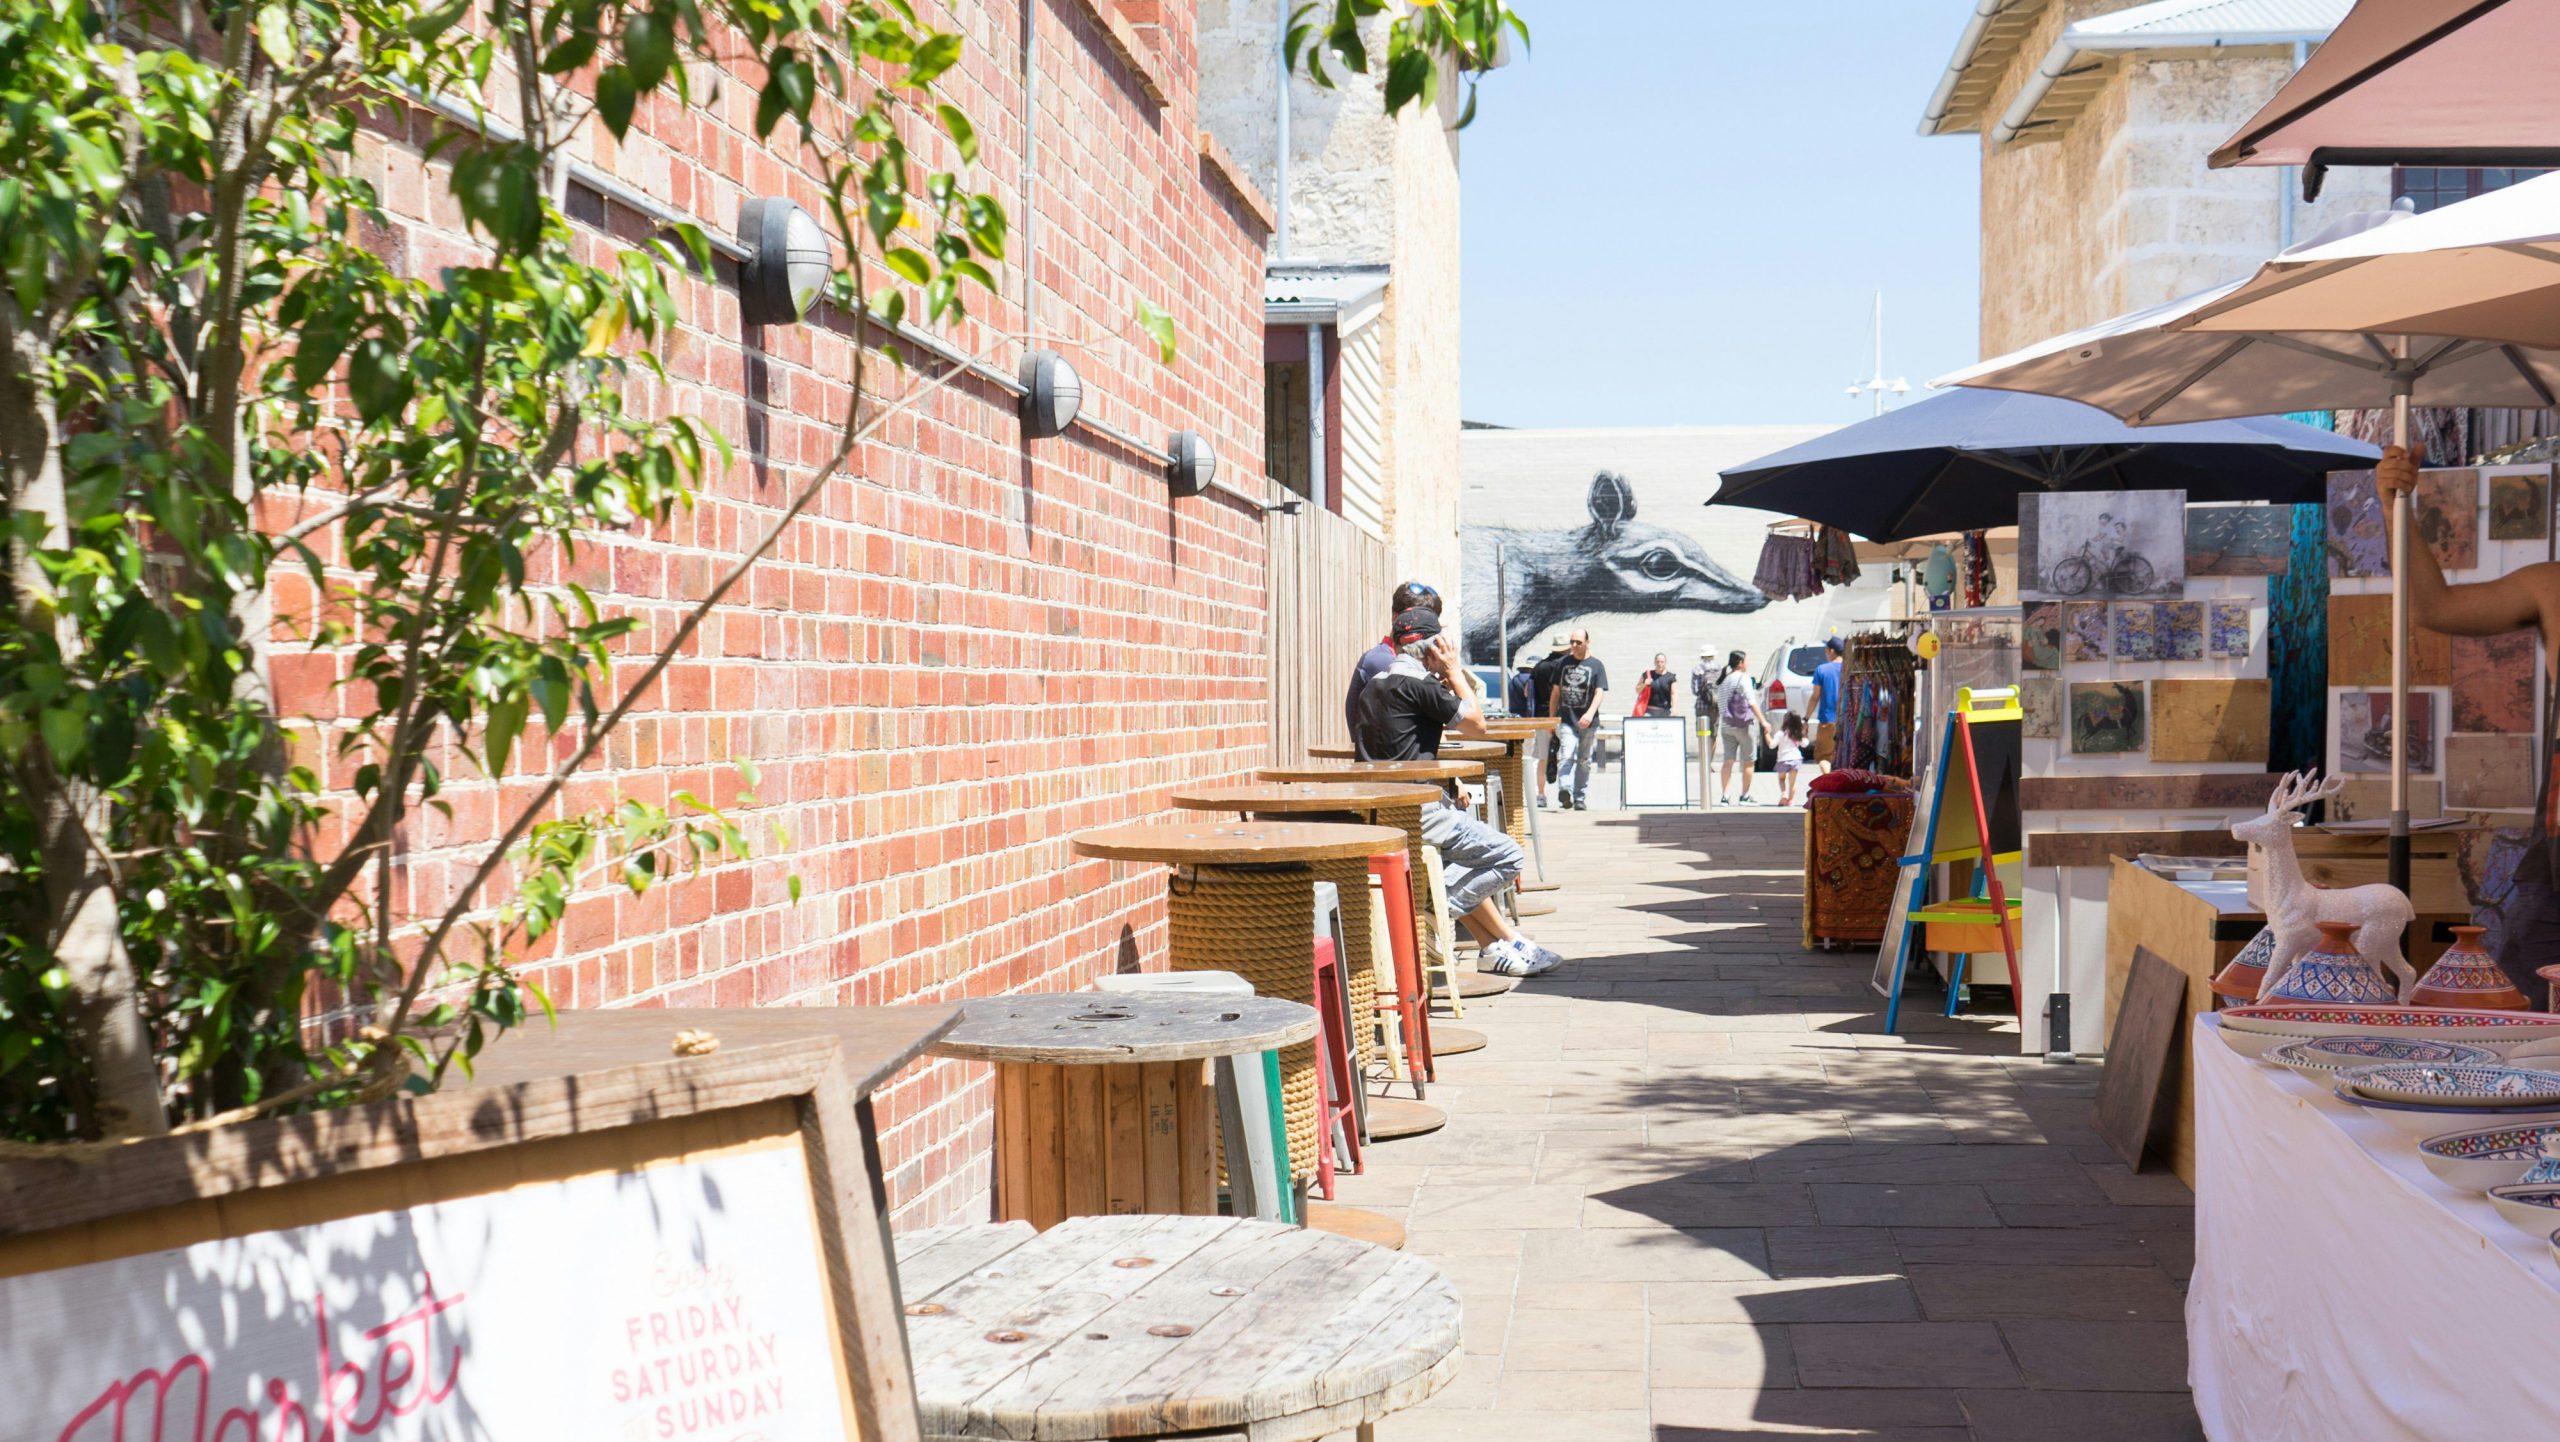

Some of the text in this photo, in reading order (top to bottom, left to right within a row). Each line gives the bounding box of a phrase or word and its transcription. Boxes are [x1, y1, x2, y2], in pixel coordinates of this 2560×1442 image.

[625, 1295, 753, 1354] FRIDAY,
[611, 1332, 777, 1403] SATURDAY
[655, 1375, 784, 1439] SUNDAY
